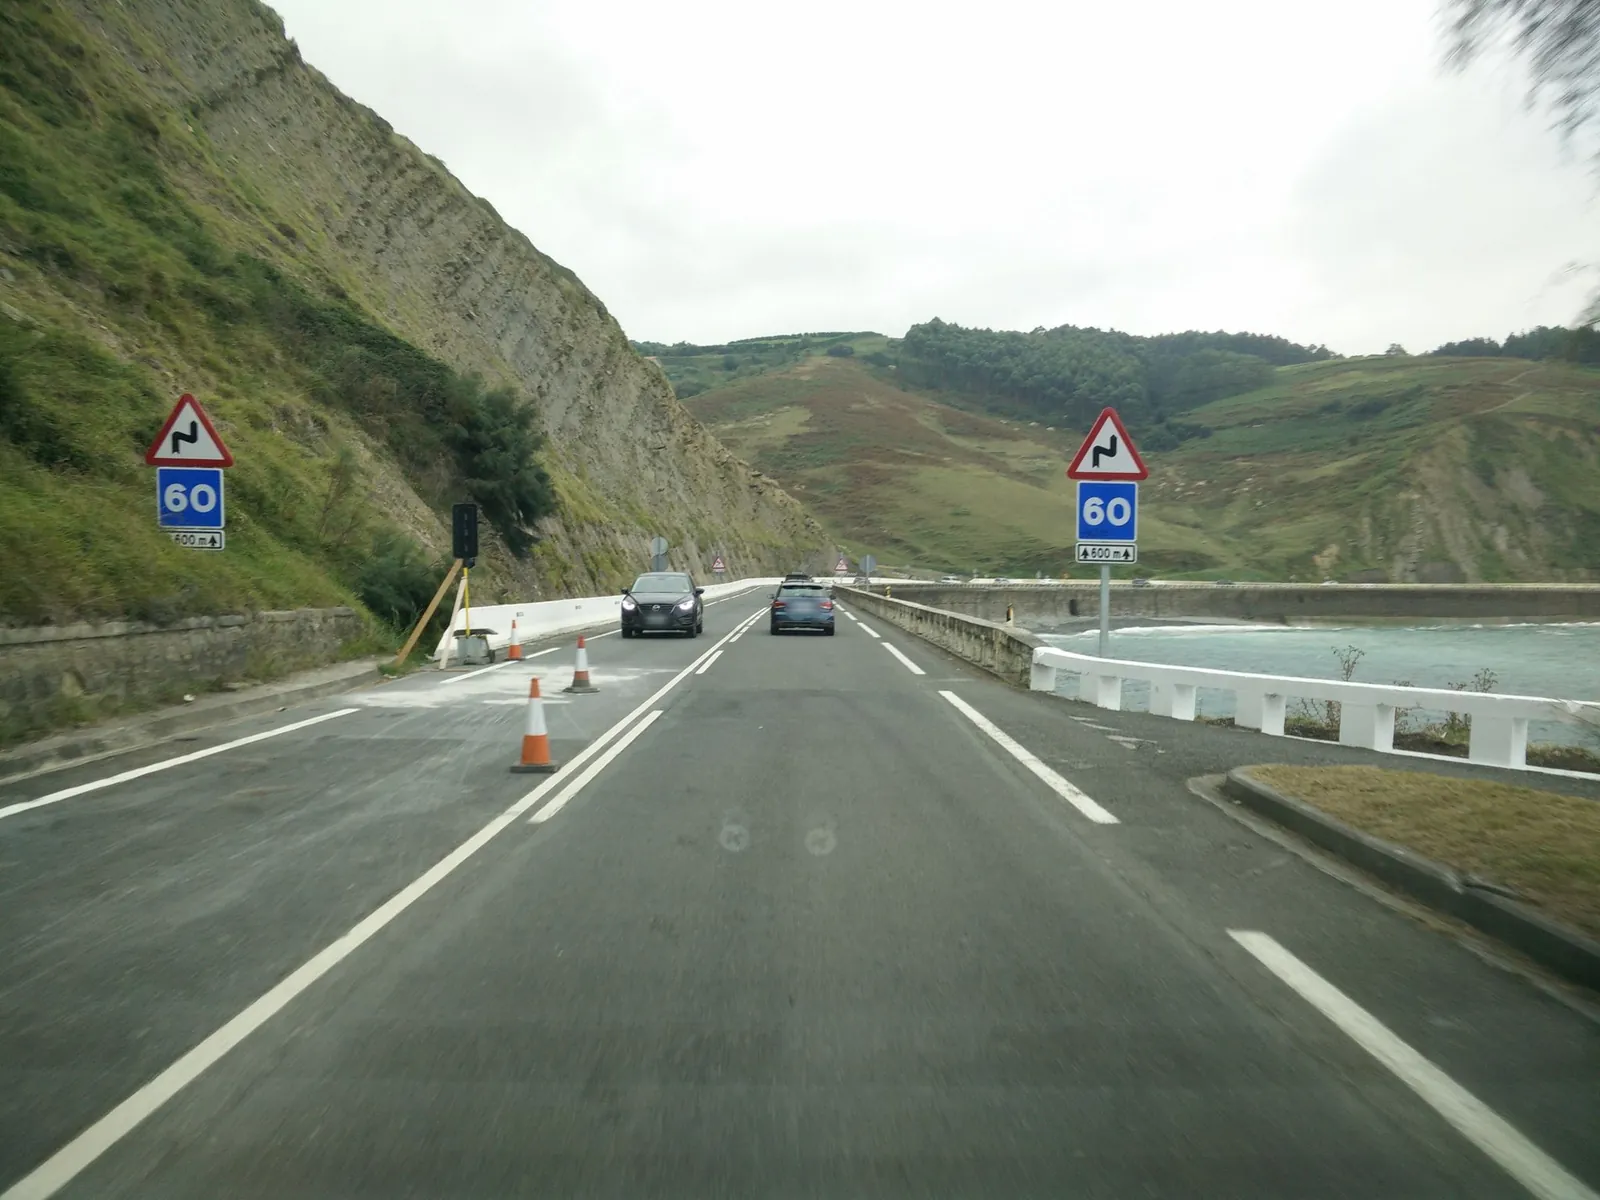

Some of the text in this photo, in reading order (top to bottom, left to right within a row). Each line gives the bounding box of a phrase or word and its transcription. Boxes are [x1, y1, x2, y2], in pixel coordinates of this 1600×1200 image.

[164, 483, 217, 513] 60
[1083, 496, 1132, 526] 60
[198, 537, 208, 545] m
[1091, 547, 1121, 559] 600 m
